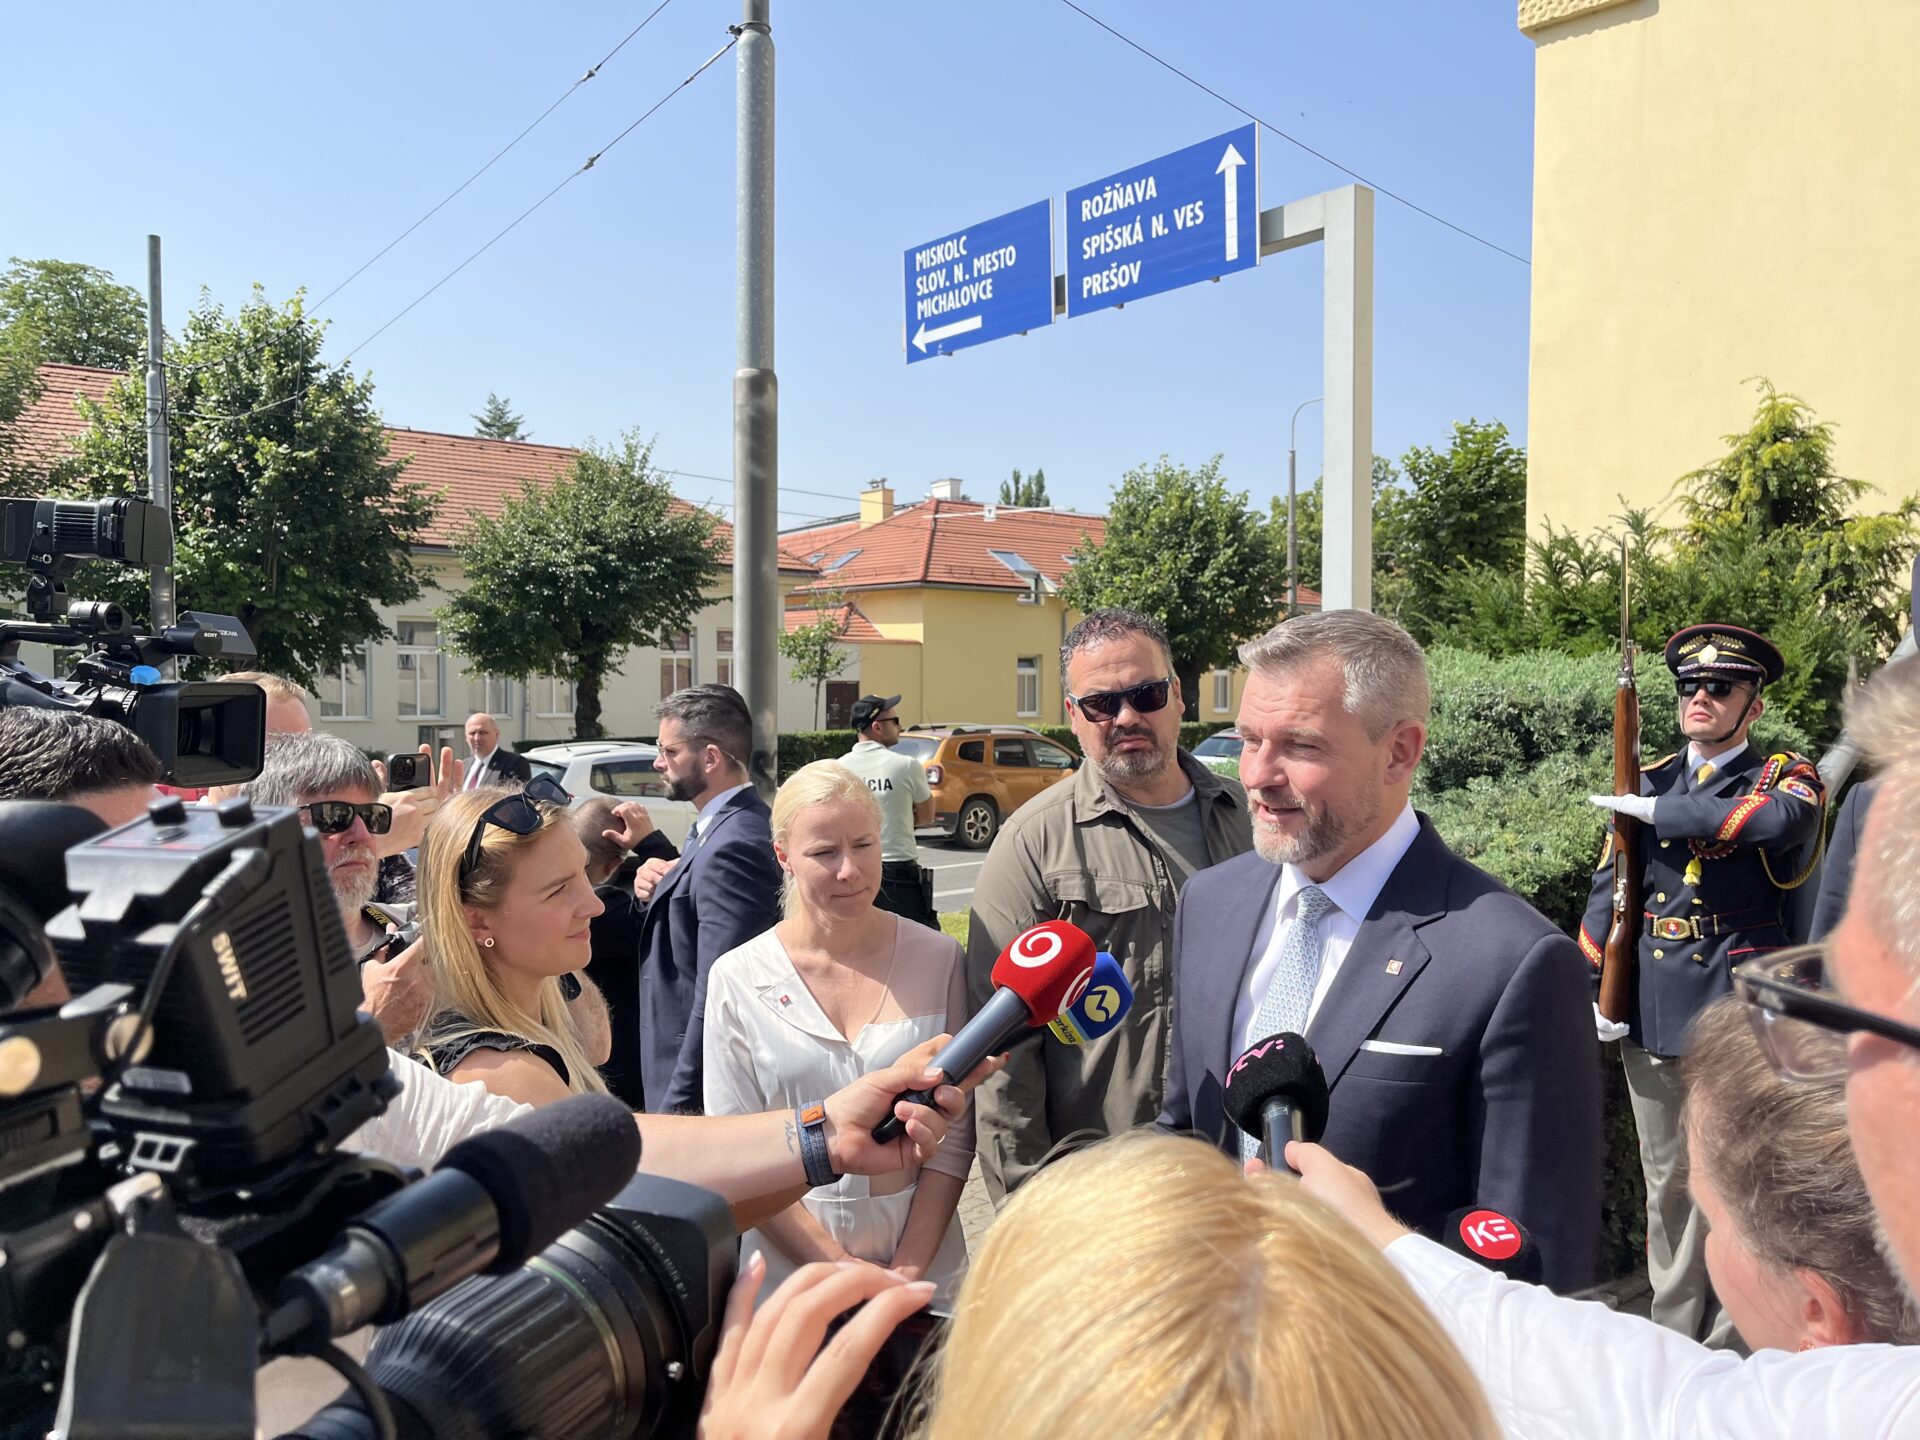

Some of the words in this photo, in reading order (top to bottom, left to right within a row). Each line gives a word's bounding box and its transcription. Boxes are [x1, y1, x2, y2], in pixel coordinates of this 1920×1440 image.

[1082, 176, 1157, 222] ROŽŇAVA
[1082, 215, 1144, 260] SPIŠSKÁ
[1151, 213, 1169, 239] N.
[1173, 200, 1204, 230] VES
[915, 235, 967, 272] MISKOLC
[916, 268, 950, 296] SLOV.
[953, 262, 970, 284] N.
[973, 245, 1016, 277] MESTO
[917, 278, 993, 320] MICHALOVCE
[1082, 260, 1141, 298] PREŠOV
[211, 931, 248, 999] SWIT
